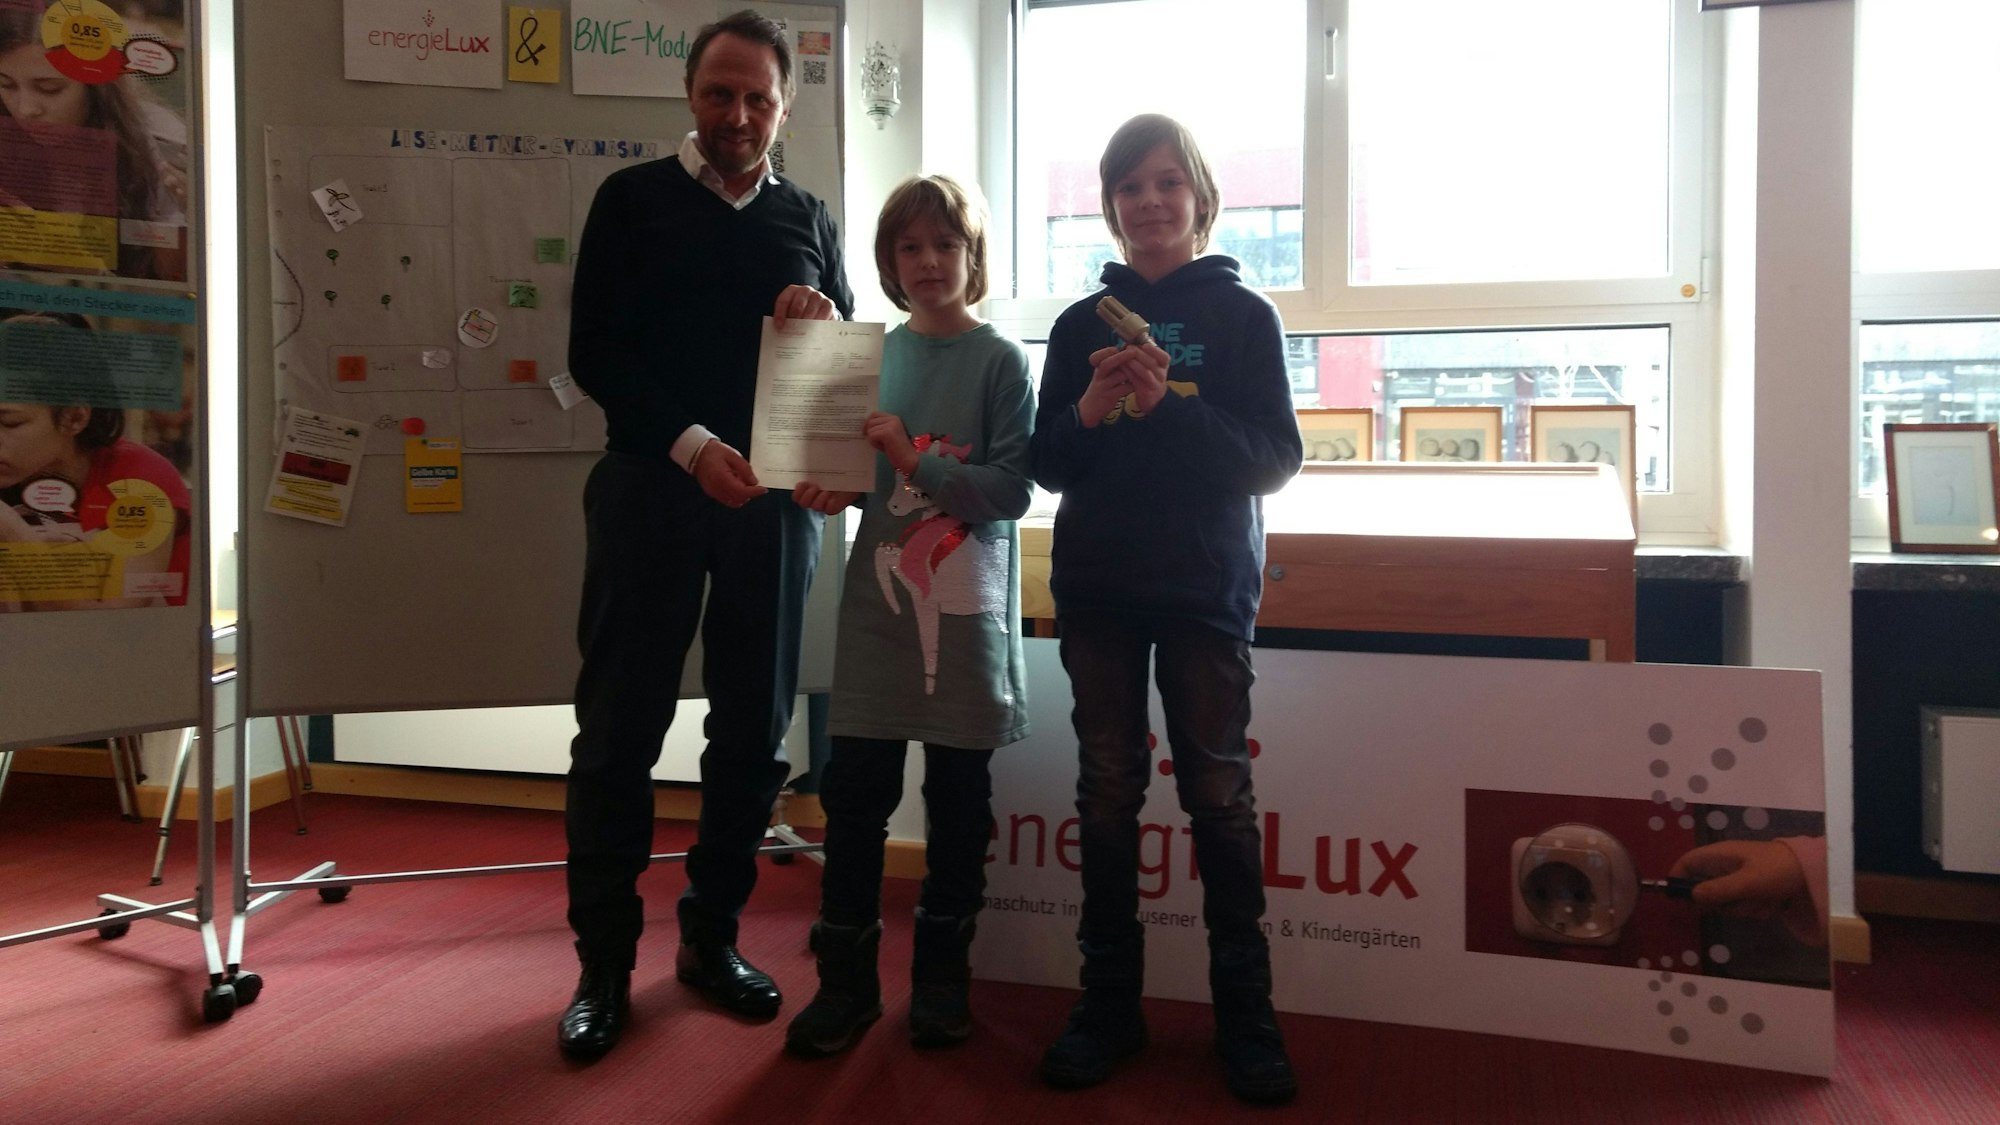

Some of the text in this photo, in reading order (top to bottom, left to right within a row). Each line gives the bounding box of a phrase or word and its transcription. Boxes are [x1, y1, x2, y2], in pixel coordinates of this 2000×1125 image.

[71, 23, 101, 38] 0,85
[367, 28, 490, 61] energieLux
[515, 17, 547, 66] &
[20, 291, 49, 306] mal
[52, 293, 81, 307] den
[84, 296, 139, 313] Stecker
[1062, 898, 1078, 917] in
[1280, 919, 1294, 938] &
[1301, 920, 1422, 949] Kindergärten
